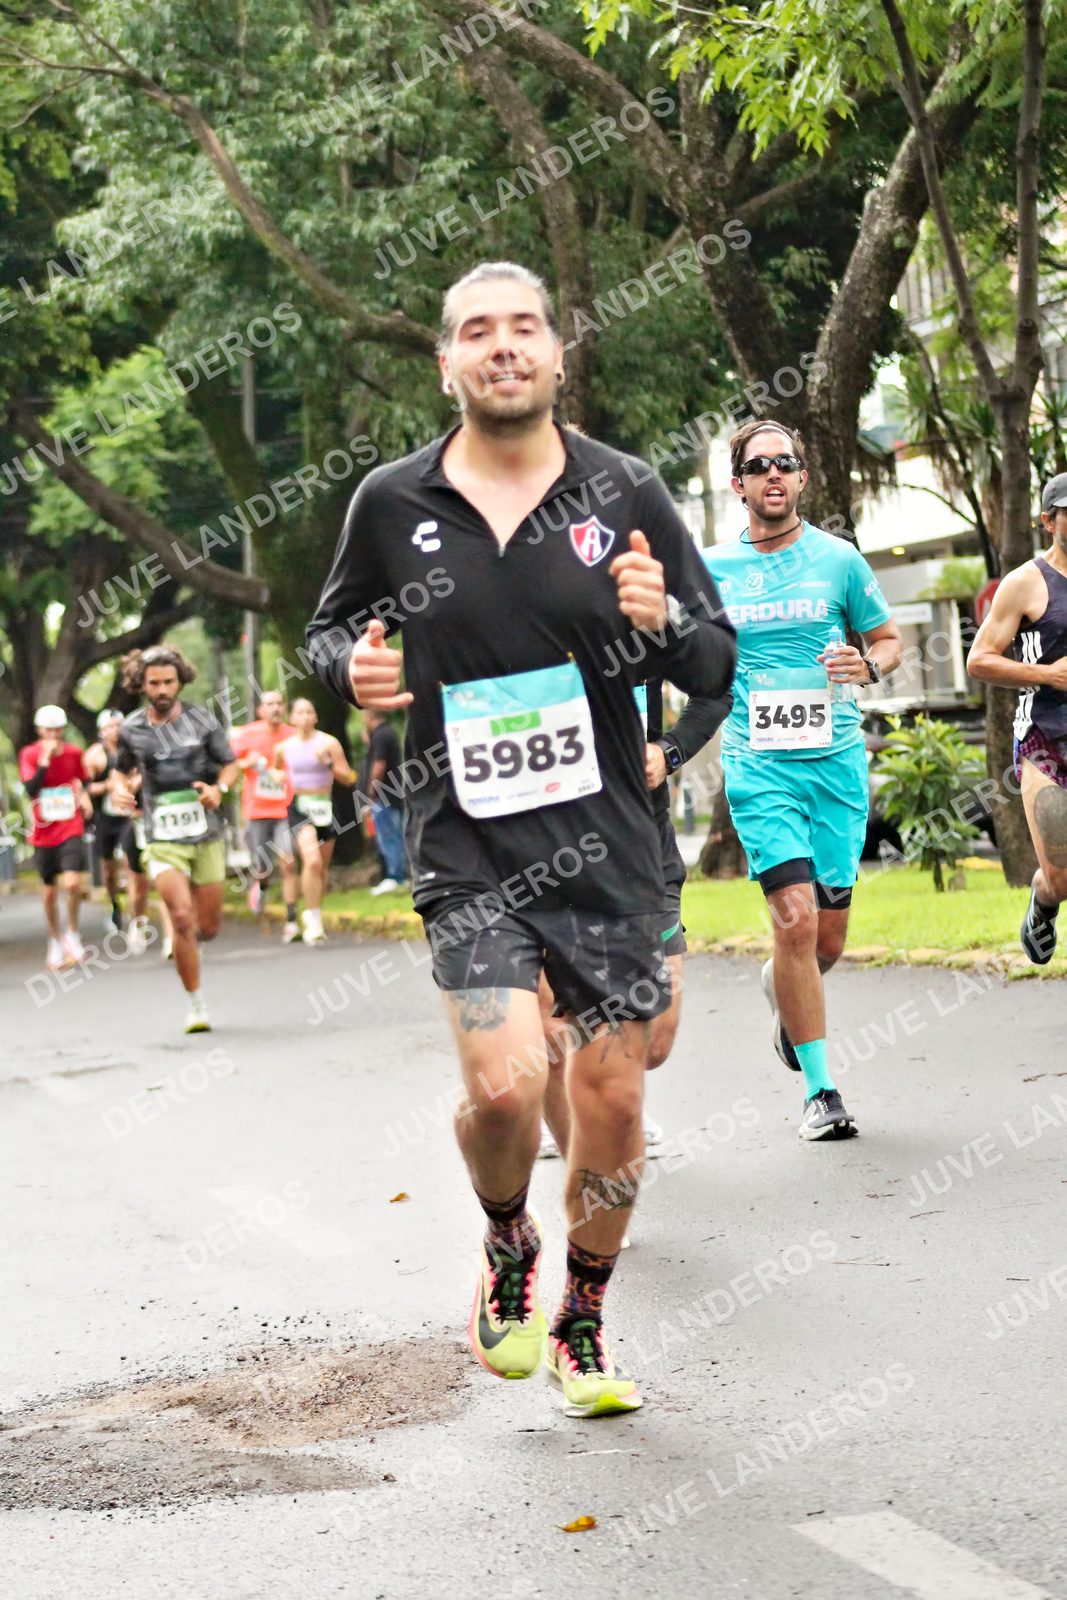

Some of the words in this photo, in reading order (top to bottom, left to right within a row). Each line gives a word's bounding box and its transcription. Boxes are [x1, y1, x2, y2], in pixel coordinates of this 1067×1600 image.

[724, 598, 829, 625] ERDURA
[755, 704, 826, 729] 3495
[462, 725, 585, 783] 5983
